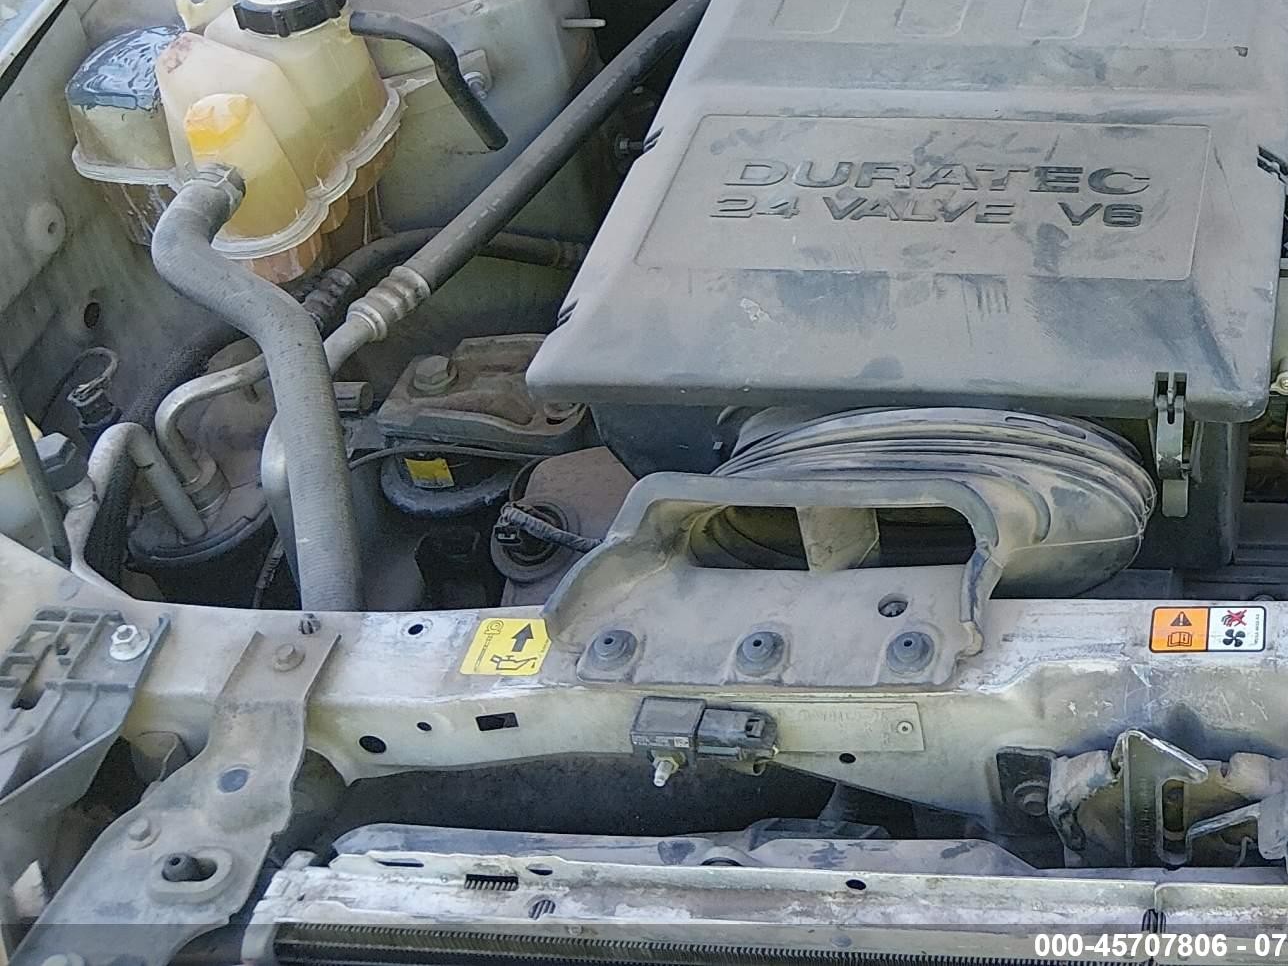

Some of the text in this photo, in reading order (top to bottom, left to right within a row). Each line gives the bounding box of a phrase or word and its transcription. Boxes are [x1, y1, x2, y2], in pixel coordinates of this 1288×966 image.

[724, 160, 1150, 195] DURATEC
[710, 194, 1144, 228] 24 VALVE V6
